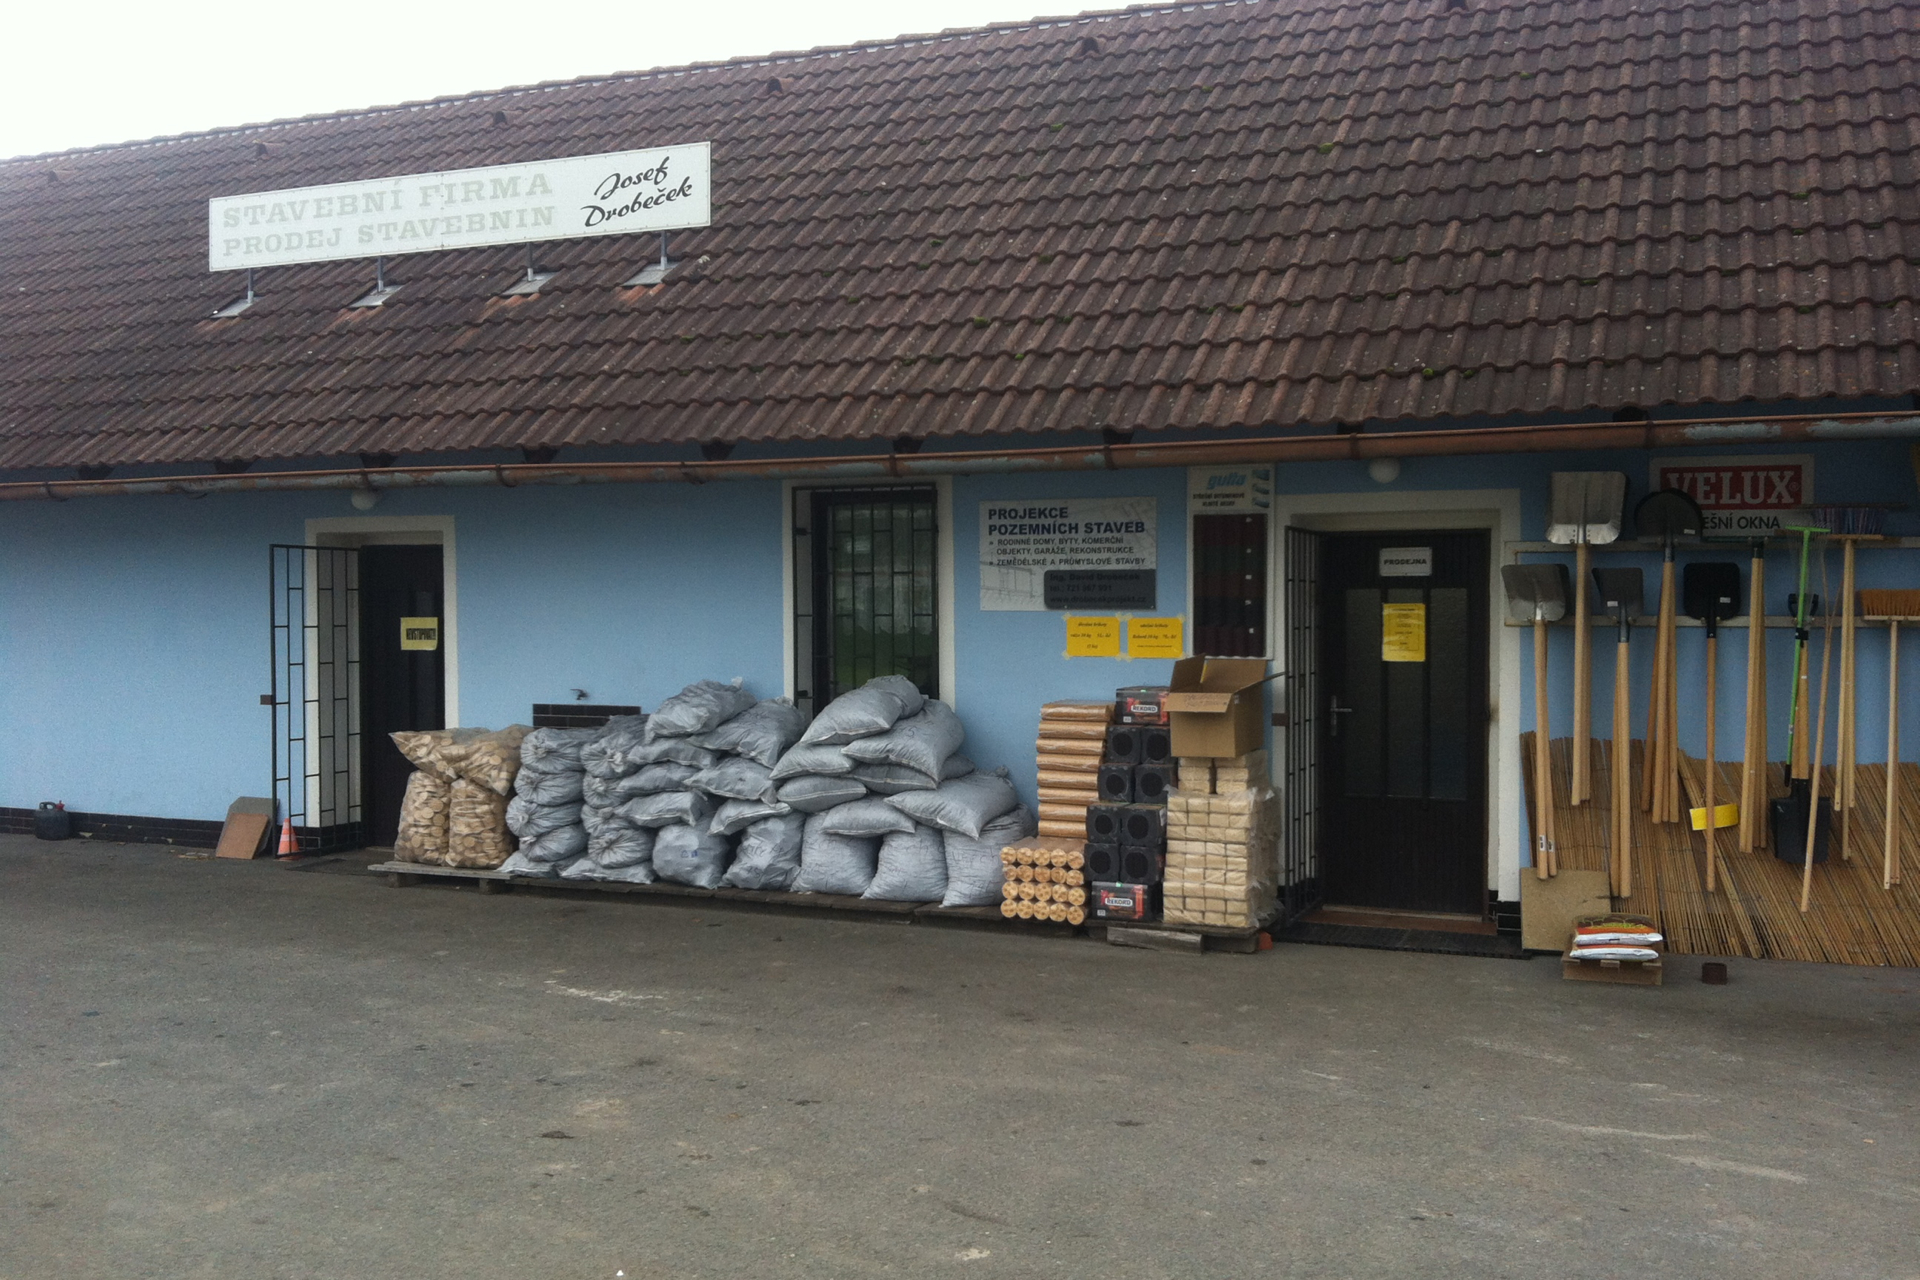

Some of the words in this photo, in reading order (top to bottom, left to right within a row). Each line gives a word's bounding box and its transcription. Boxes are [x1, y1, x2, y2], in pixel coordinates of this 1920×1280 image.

[593, 156, 670, 200] Josef
[223, 181, 402, 228] STAVEBNÍ
[419, 173, 553, 207] FIRMA
[580, 176, 693, 227] Drobeček
[223, 228, 343, 257] PRODEJ
[358, 206, 555, 244] STAVEBNIN
[1666, 470, 1795, 505] VELUX
[988, 507, 1069, 520] PROJEKCE
[1703, 512, 1733, 529] EŠNÍ
[1737, 516, 1780, 530] OKNA
[988, 520, 1079, 536] POZEMNÍCH
[1084, 521, 1145, 534] STAVEB
[997, 537, 1031, 546] RODINNÉ
[997, 547, 1032, 556] OBJEKTY,
[1069, 546, 1134, 555] REKONSTRUKCE
[1059, 556, 1112, 566] PRŮMYSLOVÉ
[1115, 557, 1146, 565] STAVBY
[1383, 558, 1427, 566] PRODEJNA
[1069, 573, 1094, 581] David
